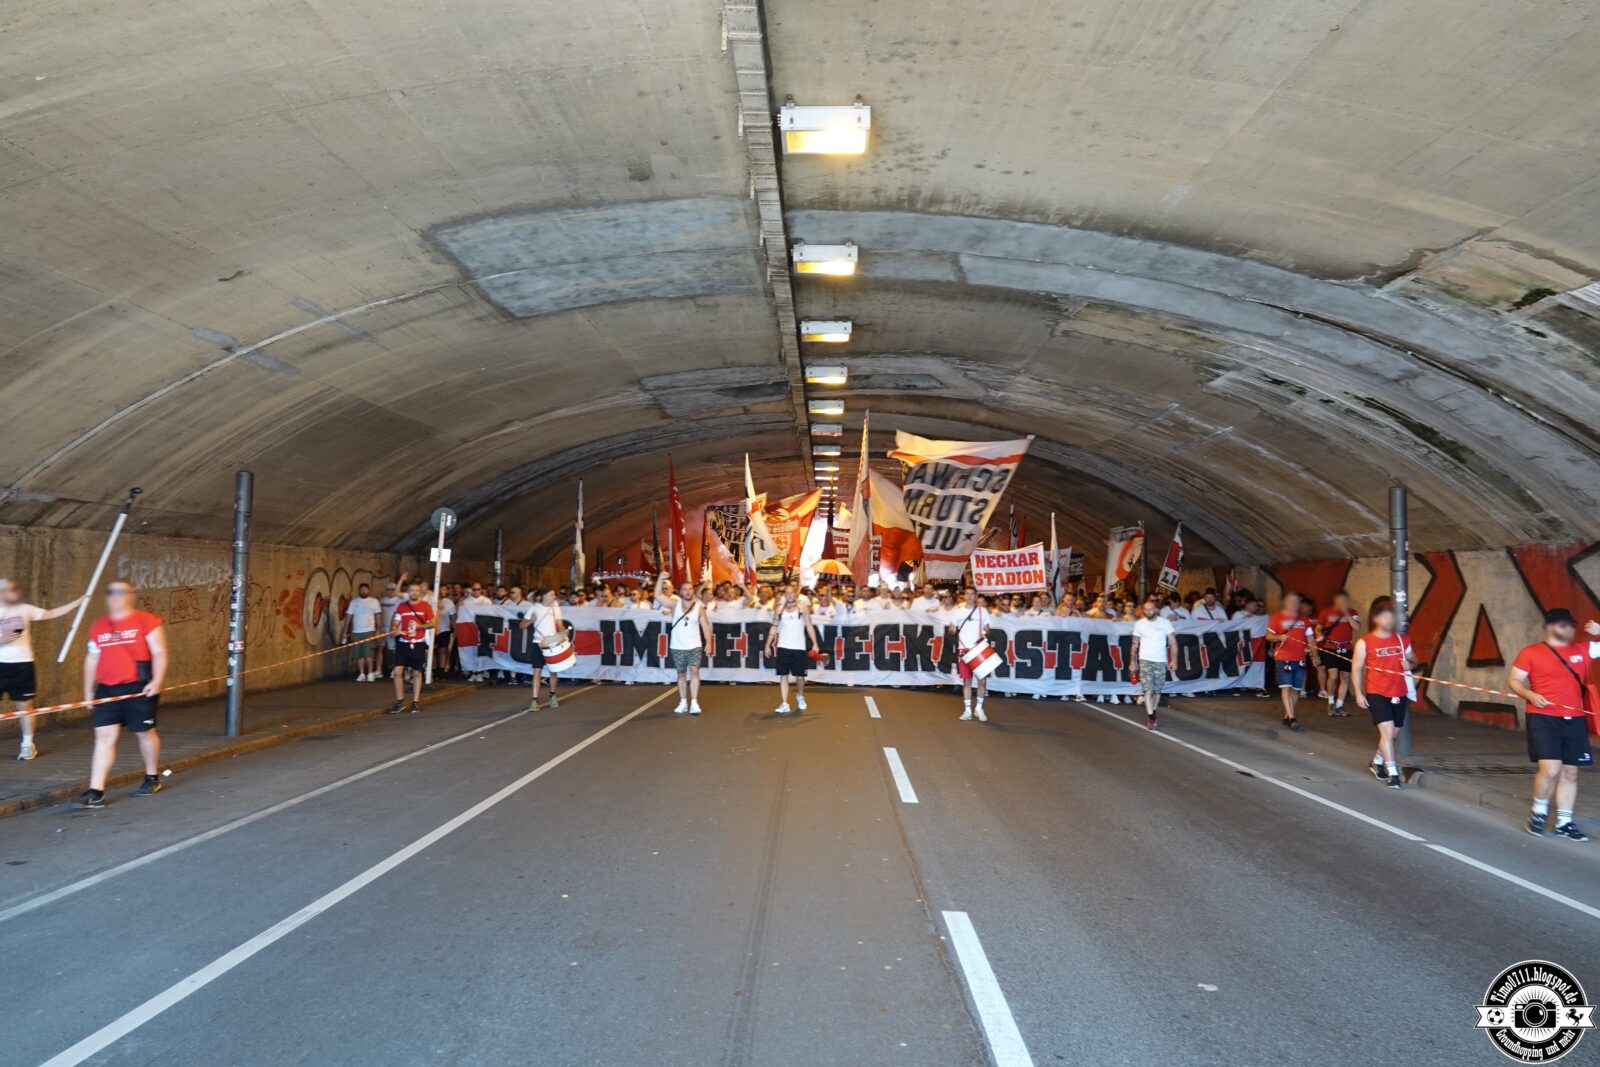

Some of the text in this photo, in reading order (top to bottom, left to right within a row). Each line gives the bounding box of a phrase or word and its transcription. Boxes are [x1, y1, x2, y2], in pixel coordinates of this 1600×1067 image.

[975, 552, 1040, 568] NECKAR
[974, 569, 1044, 586] STADION
[475, 611, 576, 666] FÜ
[805, 623, 1252, 682] NECKARSTAON!
